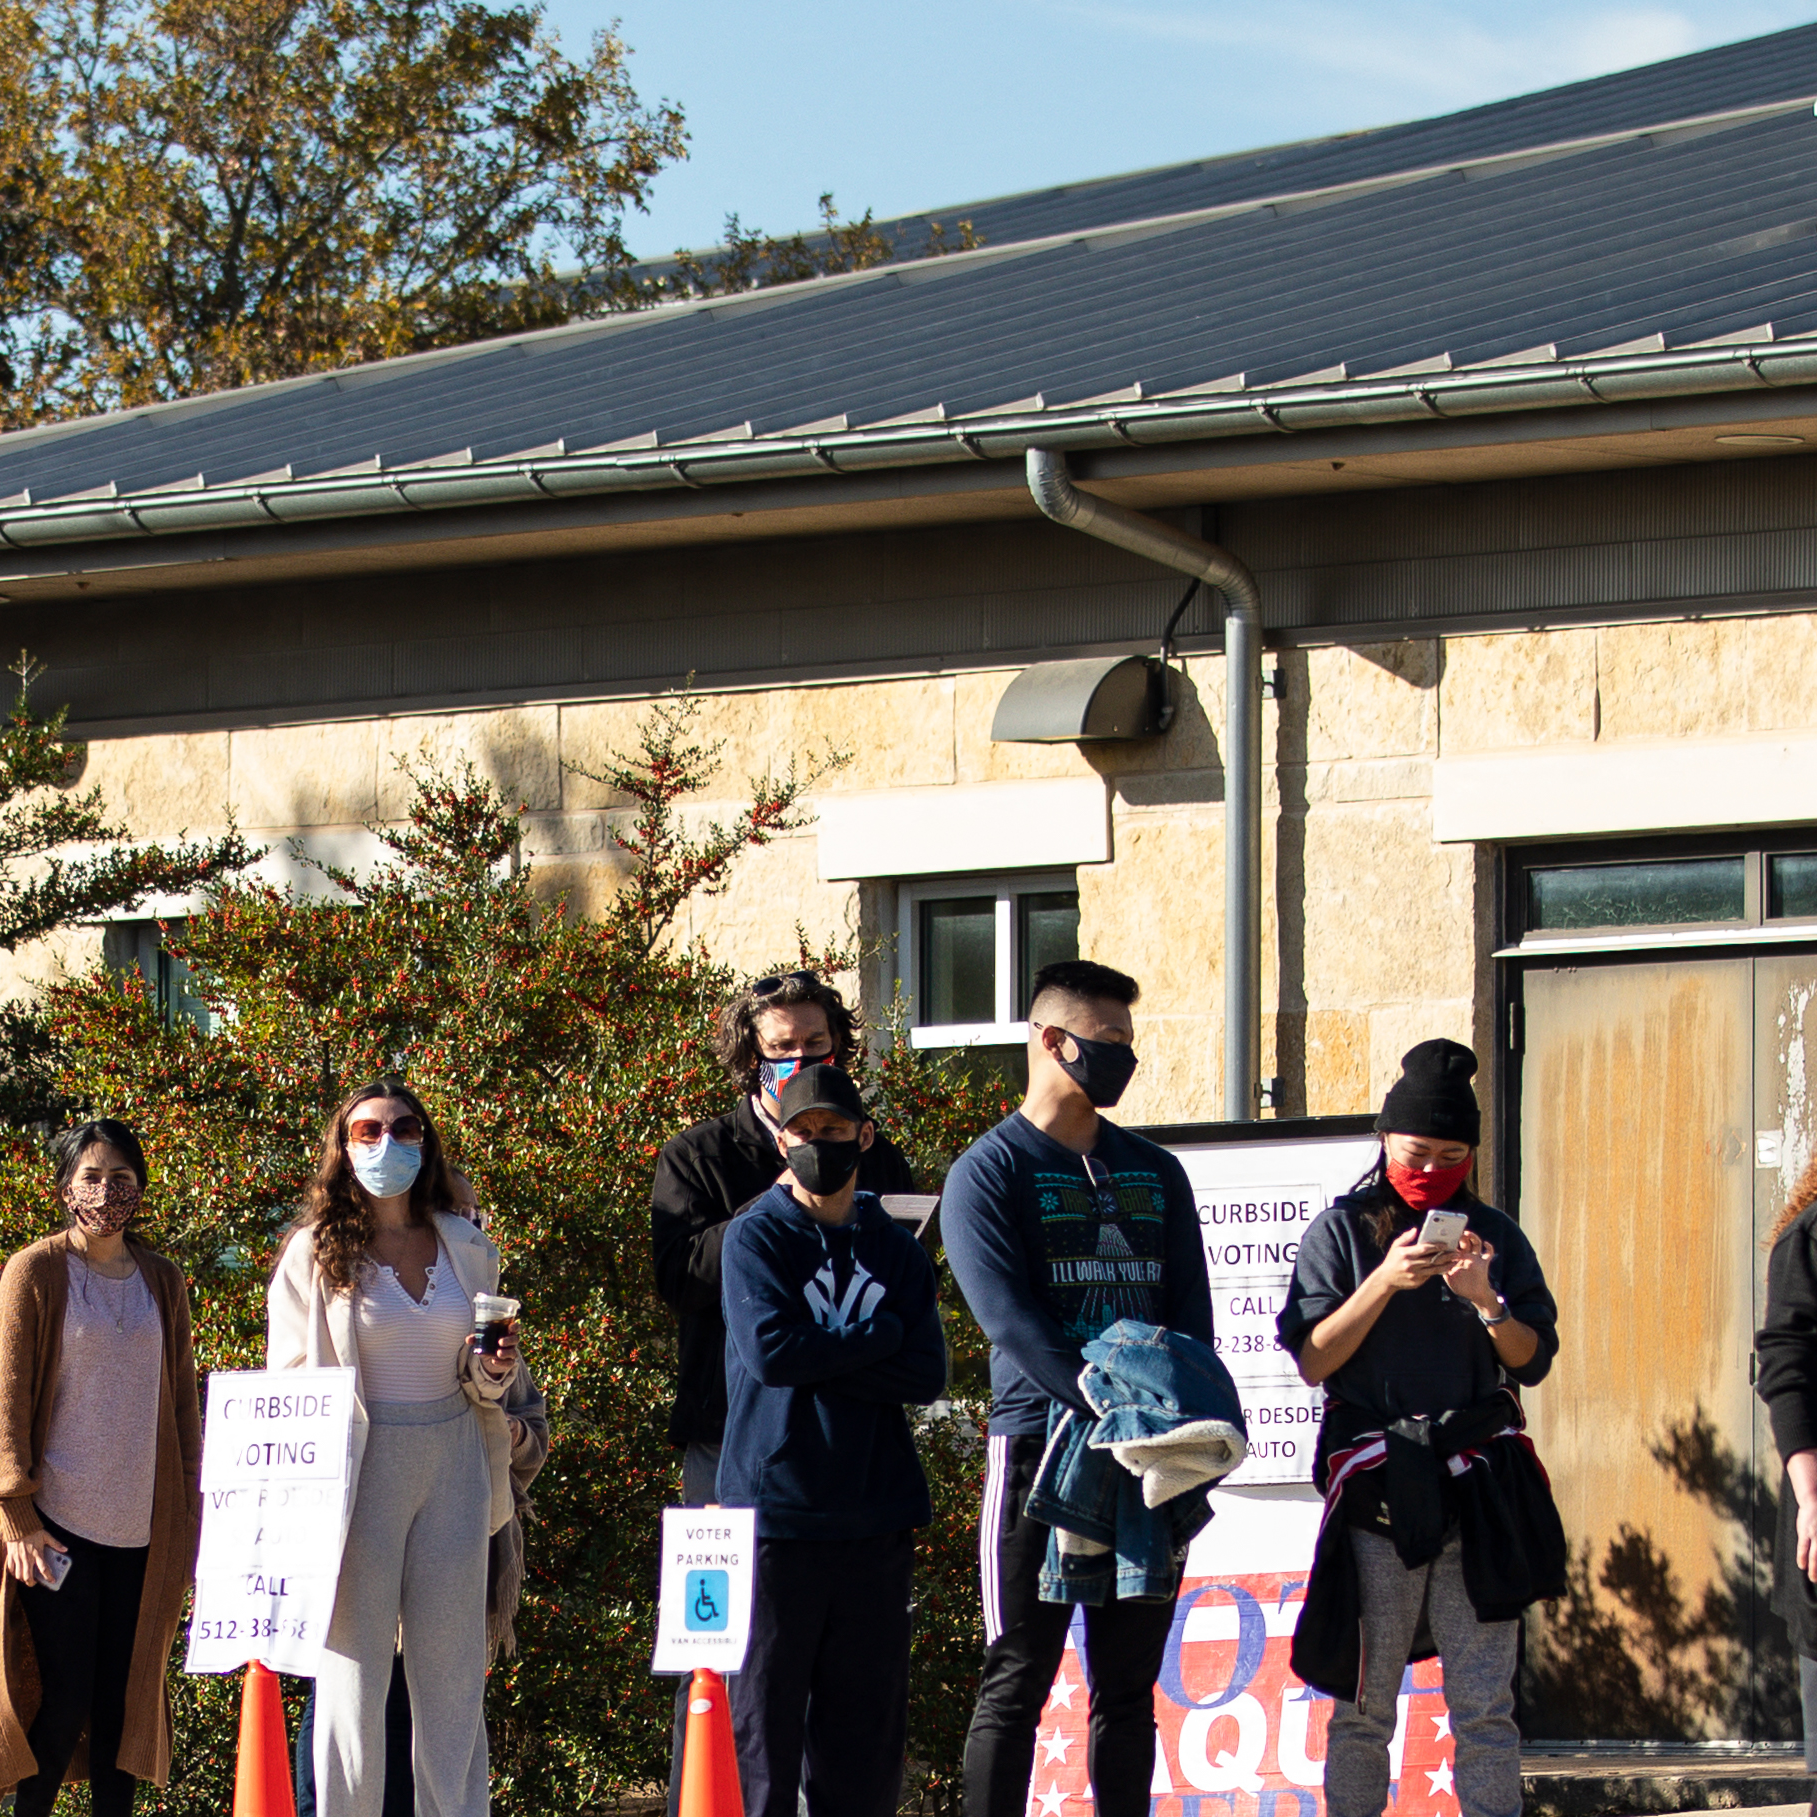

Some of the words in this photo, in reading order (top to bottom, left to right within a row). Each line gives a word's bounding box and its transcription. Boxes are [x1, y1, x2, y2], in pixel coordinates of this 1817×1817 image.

[1197, 1200, 1311, 1225] CURBSIDE
[1208, 1242, 1300, 1266] VOTING
[1076, 1261, 1117, 1282] WALK
[1229, 1296, 1278, 1316] CALL
[224, 1395, 332, 1419] CURBSIDE
[1259, 1406, 1322, 1425] DESDE
[1246, 1440, 1296, 1459] AUTO
[686, 1528, 732, 1541] VOTER
[676, 1553, 739, 1566] PARKING
[671, 1637, 689, 1645] VAN
